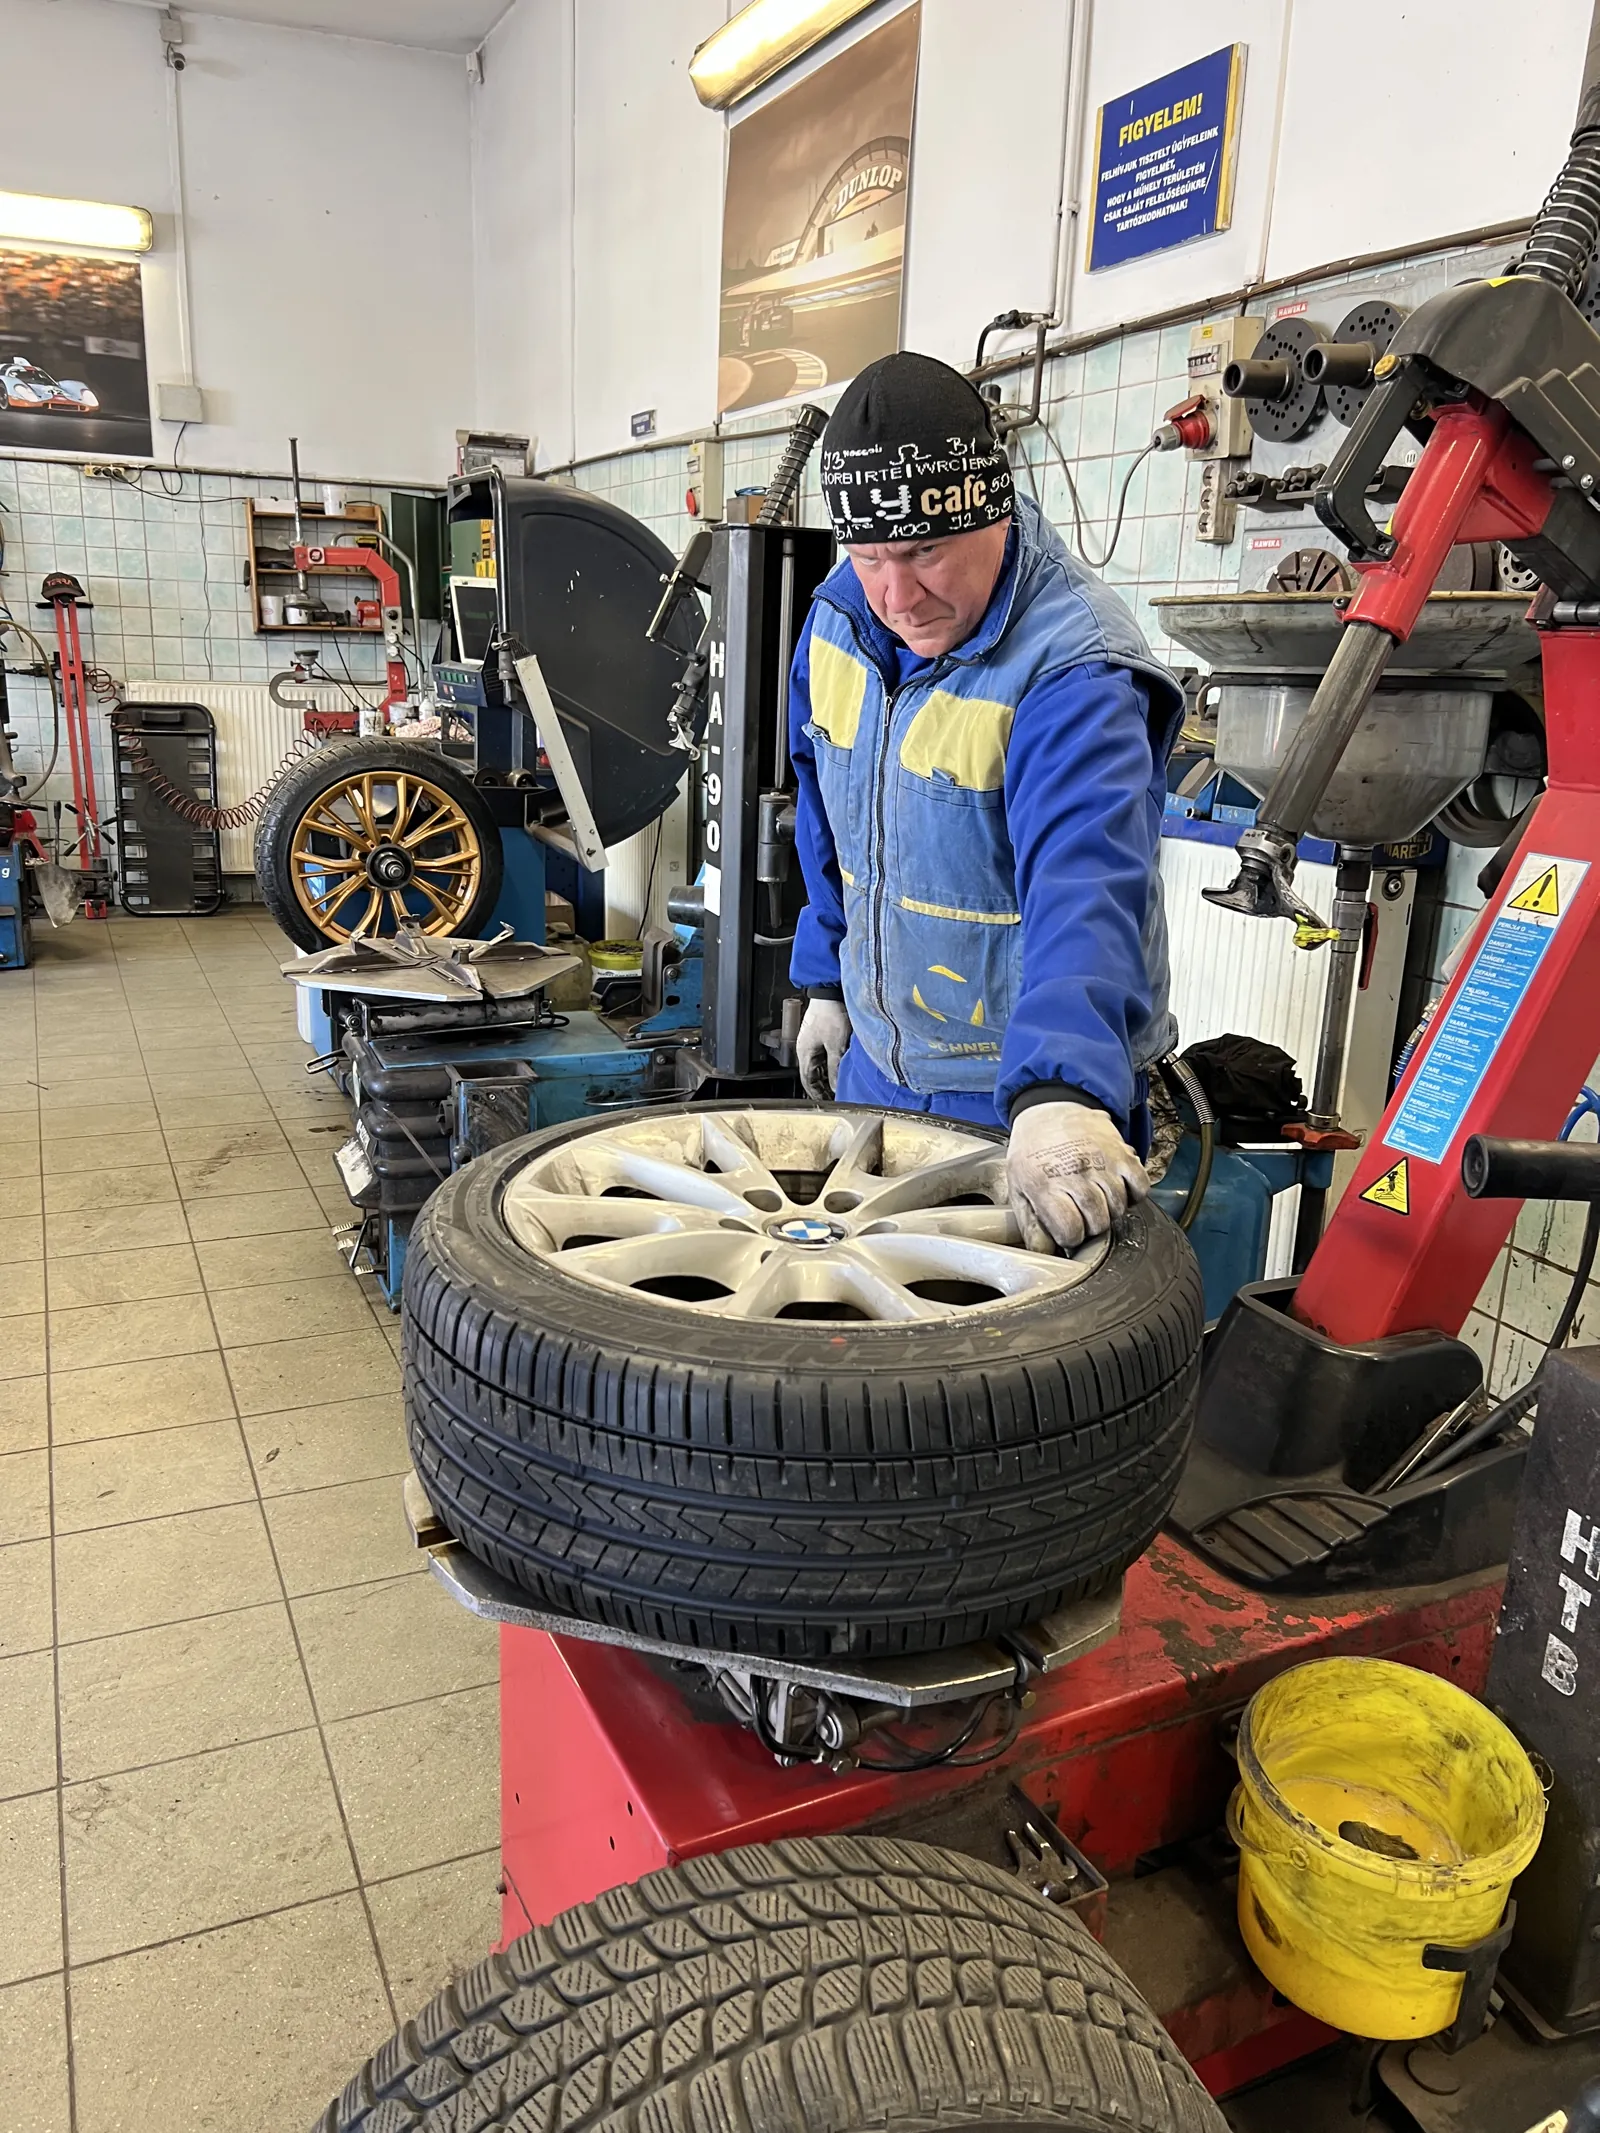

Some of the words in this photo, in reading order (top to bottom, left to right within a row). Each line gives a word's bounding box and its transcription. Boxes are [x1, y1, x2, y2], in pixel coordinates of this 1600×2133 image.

[1119, 93, 1203, 147] FIGYELEM!
[1101, 159, 1137, 182] FELHÍVJUK
[1138, 145, 1171, 167] TISZTELT
[1135, 158, 1176, 183] FIGYELMÉT,
[836, 165, 903, 212] DUNLOP
[1107, 192, 1126, 208] HOGY
[1126, 191, 1132, 200] A
[1103, 209, 1122, 223] CSAK
[1123, 200, 1144, 216] SAJÁT
[1116, 199, 1188, 232] TARTÓZKODHATNAK!
[921, 474, 986, 516] café
